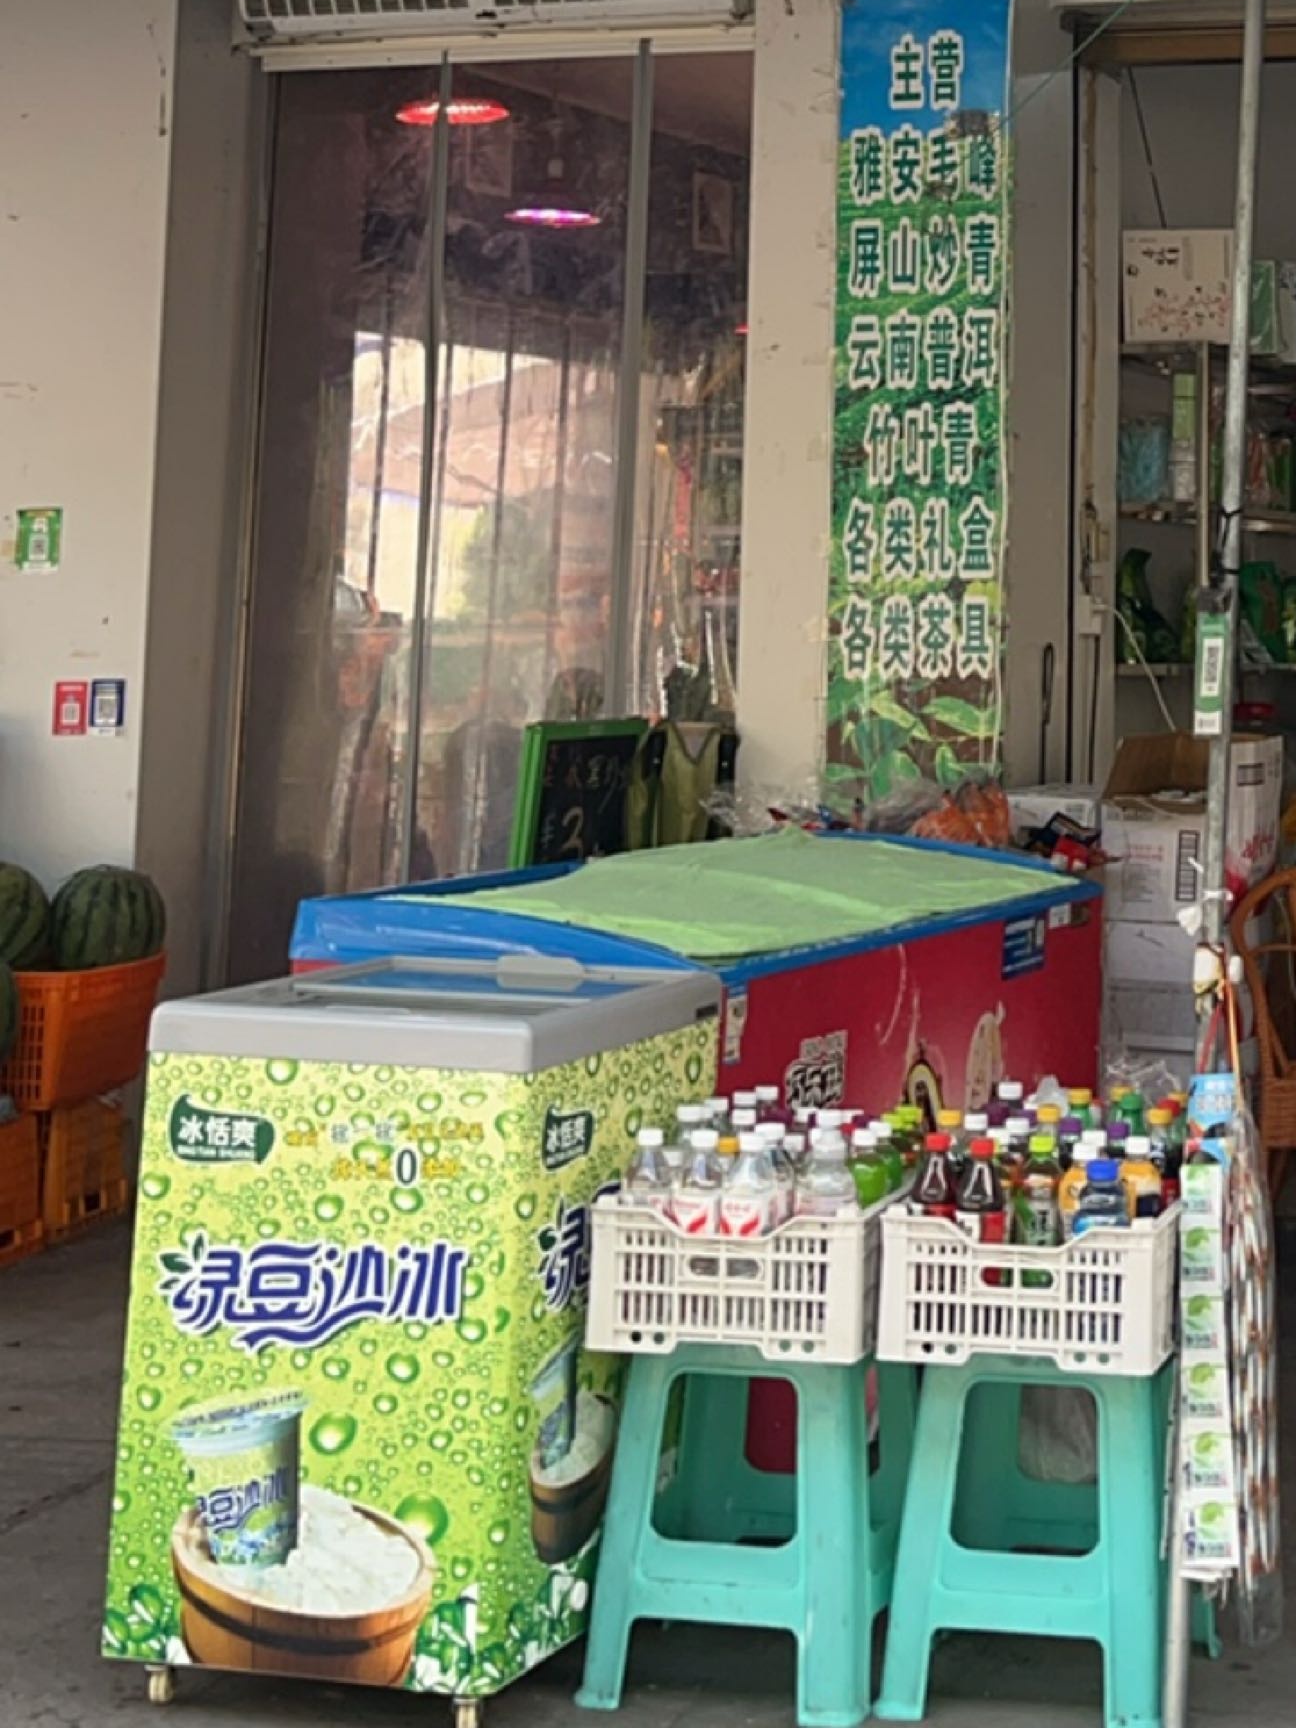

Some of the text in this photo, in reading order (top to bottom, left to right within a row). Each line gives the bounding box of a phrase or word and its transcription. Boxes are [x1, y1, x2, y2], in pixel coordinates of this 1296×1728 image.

[890, 30, 963, 110] 主营
[850, 124, 1000, 206] 雅安毛峰
[848, 213, 999, 298] 屏山炒青
[848, 306, 1000, 390] 云南普洱
[864, 401, 979, 486] 竹叶青
[843, 495, 996, 581] 各类礼盒
[841, 592, 994, 680] 各类茶具
[159, 1234, 469, 1354] 绿豆沙冰
